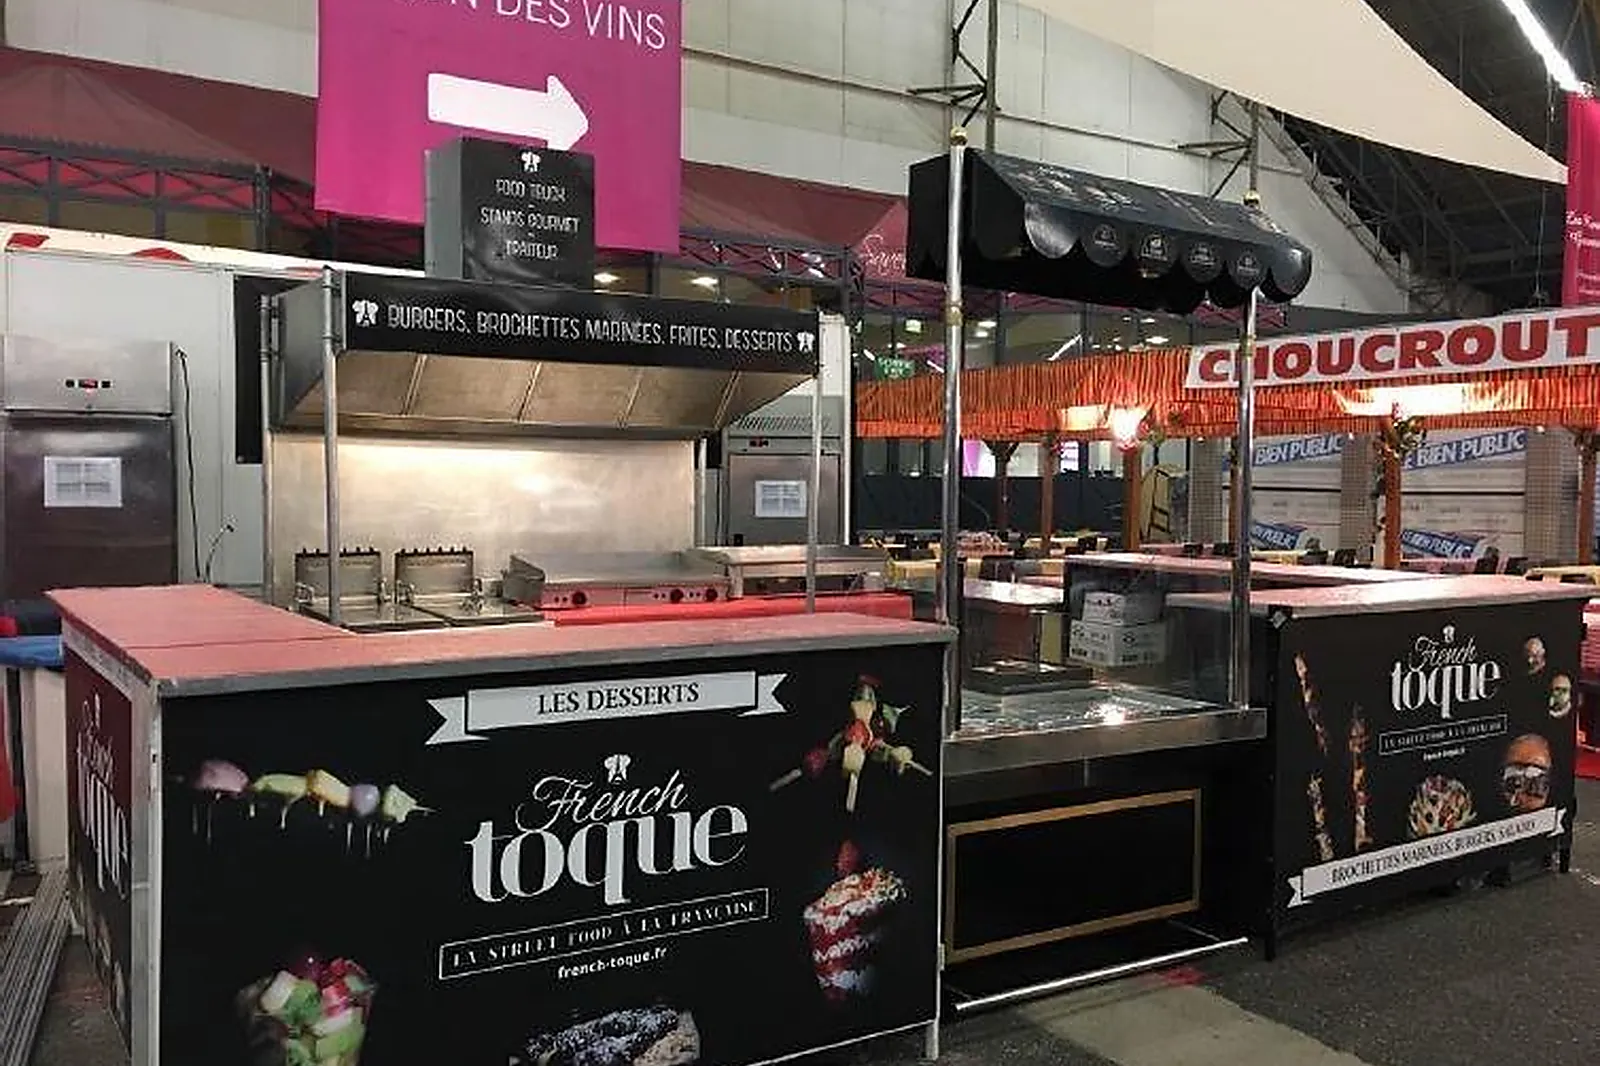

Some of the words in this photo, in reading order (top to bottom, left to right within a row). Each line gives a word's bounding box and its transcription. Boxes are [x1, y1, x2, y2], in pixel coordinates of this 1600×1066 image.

[581, 0, 666, 49] VINS
[476, 310, 581, 340] BROCHETTES
[725, 327, 793, 351] DESSERTS
[1289, 433, 1343, 459] PUBLIC
[1416, 443, 1457, 467] BIEN
[1459, 430, 1525, 460] PUBLIC
[538, 690, 580, 715] LES
[586, 681, 700, 711] DESSERTS
[1391, 660, 1501, 719] toque
[514, 769, 688, 833] French
[463, 804, 748, 906] toque
